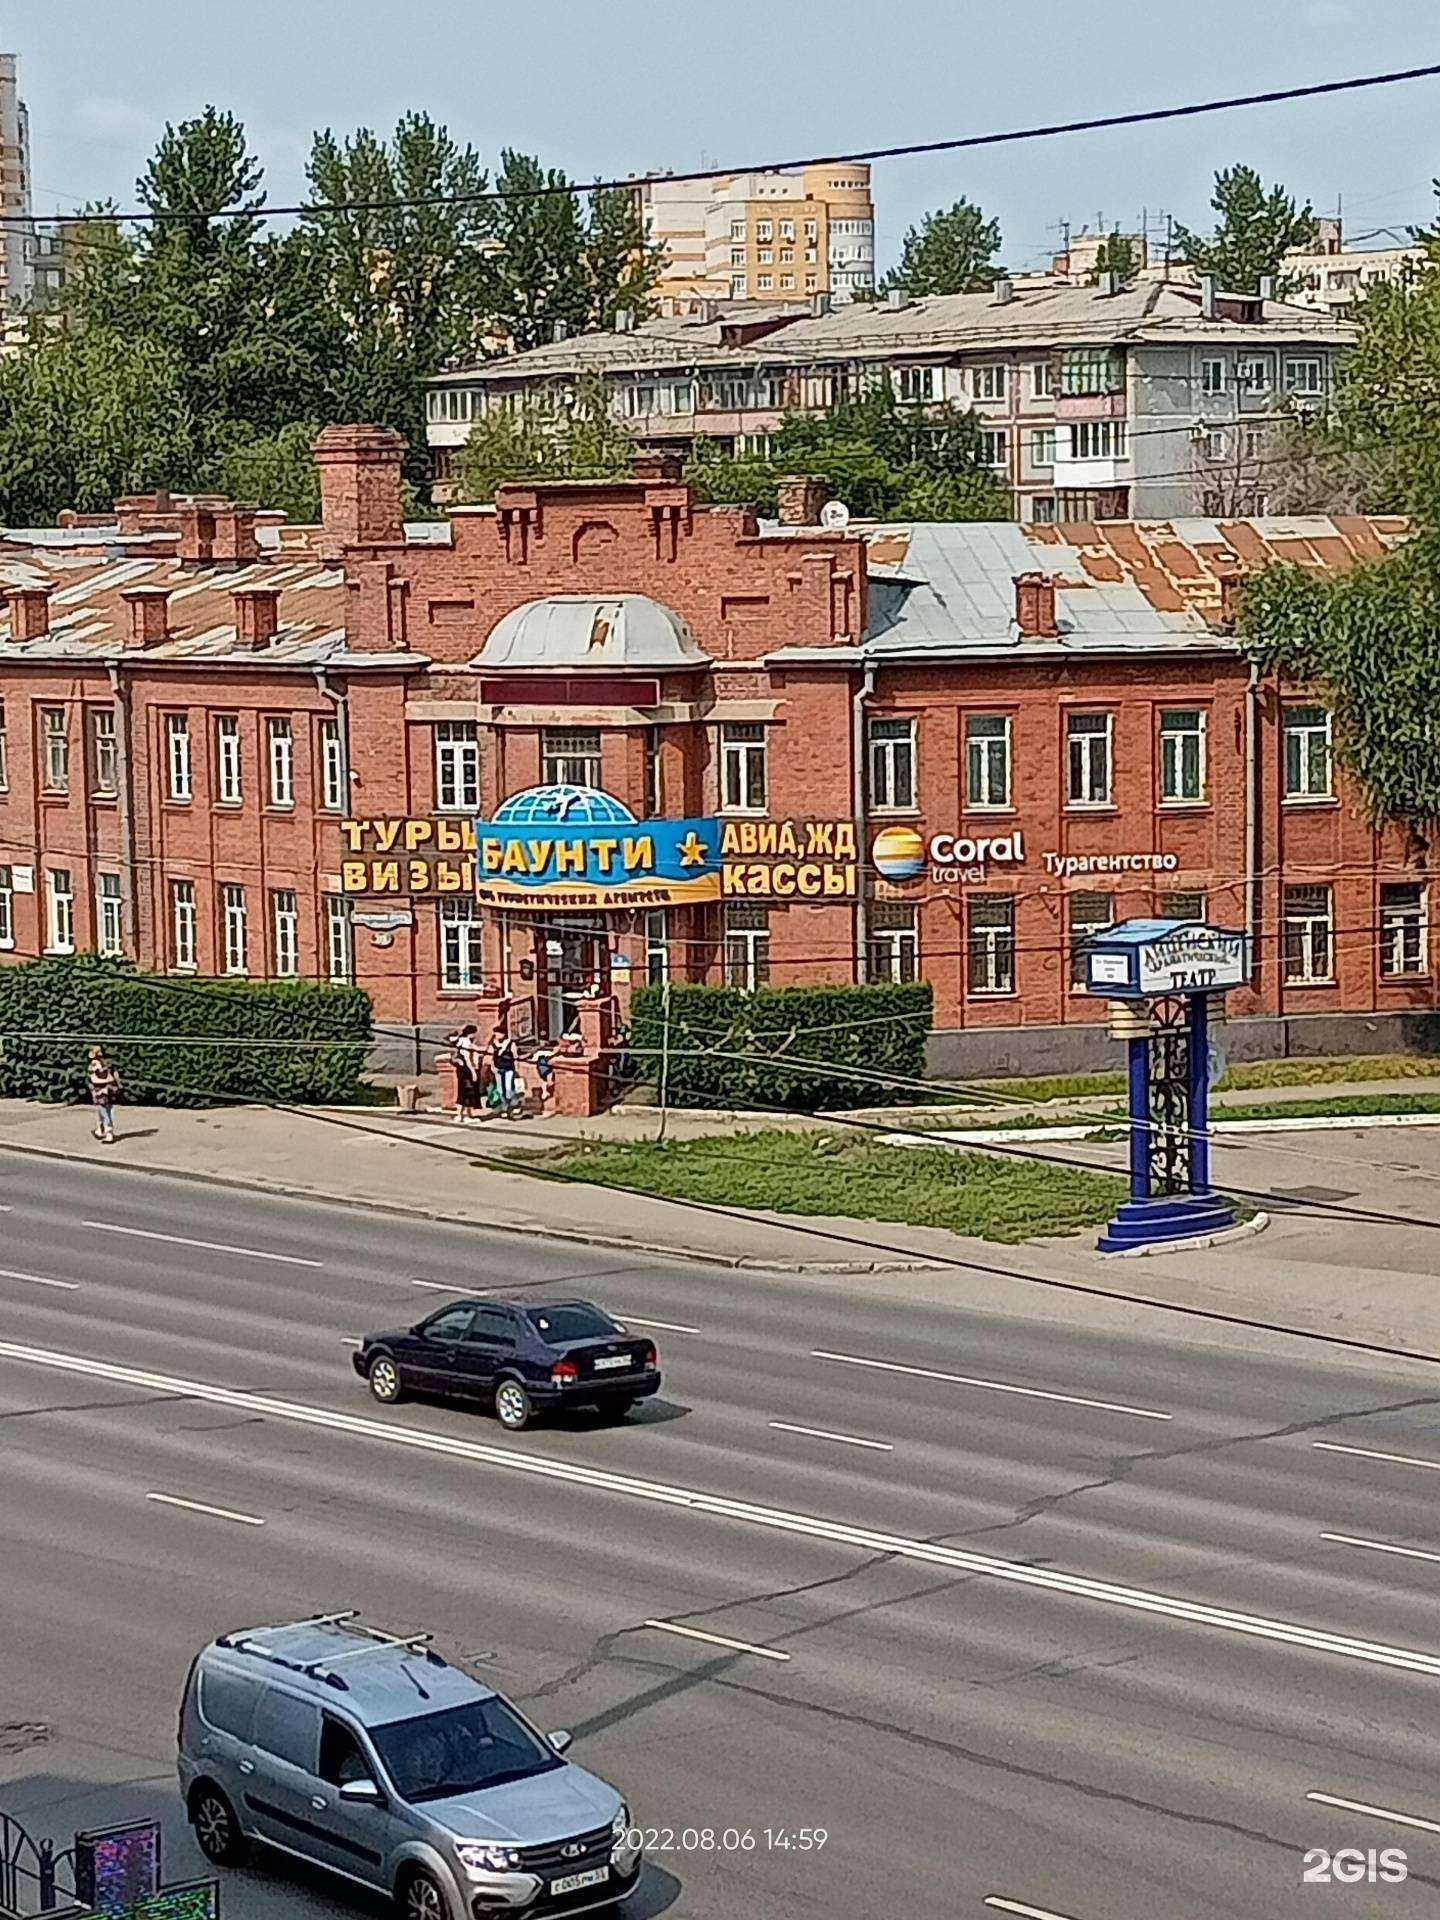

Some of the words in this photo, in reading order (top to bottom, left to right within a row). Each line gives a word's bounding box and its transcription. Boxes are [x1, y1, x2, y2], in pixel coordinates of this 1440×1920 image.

[341, 821, 477, 851] ТУРЫ
[931, 832, 1024, 862] Coral
[482, 836, 653, 873] БАУНТИ
[1042, 852, 1177, 877] Турагентство
[343, 861, 473, 891] ВИЗЫ
[932, 865, 985, 882] travel
[1170, 969, 1216, 990] ТЕАТР
